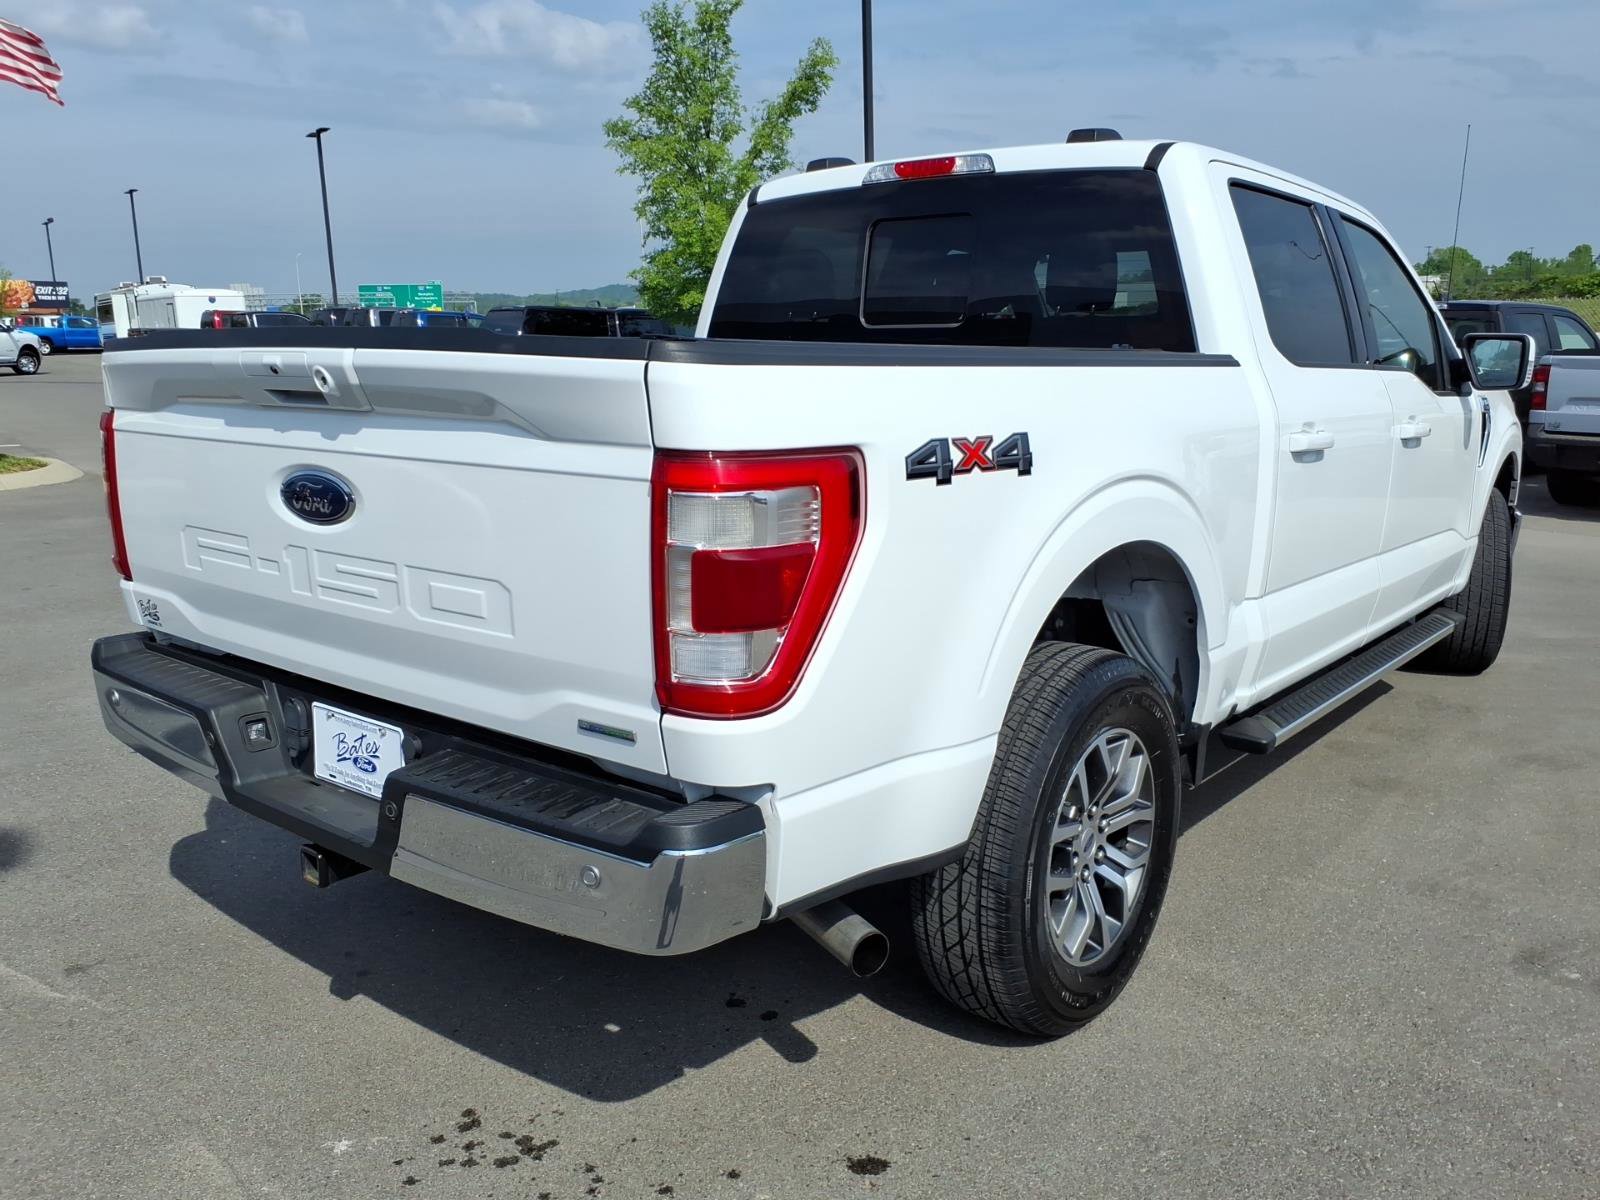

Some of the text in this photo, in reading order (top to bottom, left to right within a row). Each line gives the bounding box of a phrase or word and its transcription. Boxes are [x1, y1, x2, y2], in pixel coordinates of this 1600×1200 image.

[35, 286, 52, 295] EXIT
[292, 481, 334, 513] Ford
[181, 525, 514, 638] F-150
[332, 732, 381, 757] Bates
[356, 757, 374, 771] Ford
